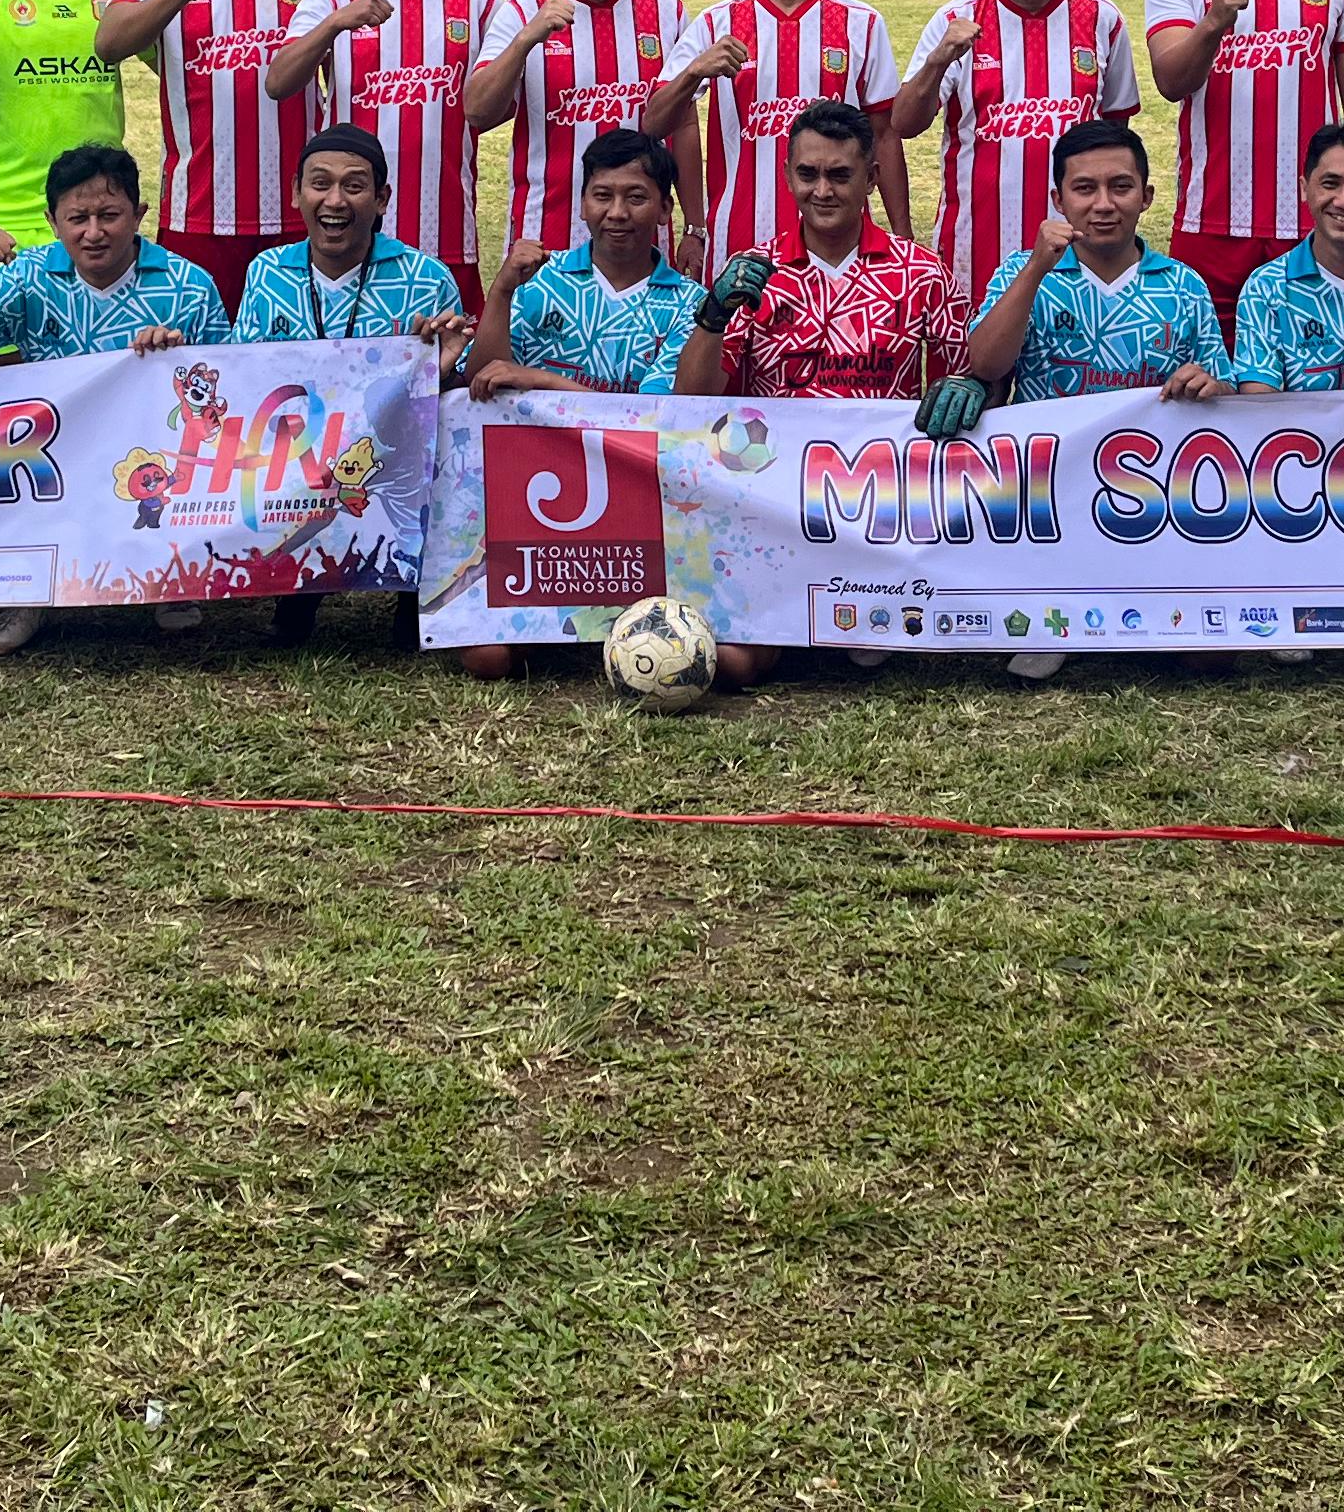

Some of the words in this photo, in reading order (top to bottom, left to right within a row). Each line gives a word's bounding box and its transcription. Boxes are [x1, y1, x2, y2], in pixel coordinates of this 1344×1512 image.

[197, 27, 288, 52] WONOSOBO
[1222, 27, 1311, 49] WONOSOBO
[19, 77, 47, 85] PSSI
[365, 65, 453, 86] WONOSOBO
[559, 81, 648, 102] WONOSOBO
[988, 97, 1082, 118] WONOSOBO
[783, 343, 895, 389] Jurnalis
[526, 430, 609, 532] J
[800, 432, 1062, 544] MINI
[172, 501, 202, 514] HARI
[205, 500, 236, 513] PERS
[263, 497, 336, 510] WONOSOBO
[169, 513, 233, 527] NASIONAL
[262, 511, 304, 524] JATENG
[537, 546, 644, 559] KOMUNITAS
[539, 581, 644, 593] WONOSOBO
[827, 576, 907, 596] Sponsored
[912, 579, 935, 600] By
[956, 614, 988, 626] PSSI
[1239, 607, 1279, 623] AQUA
